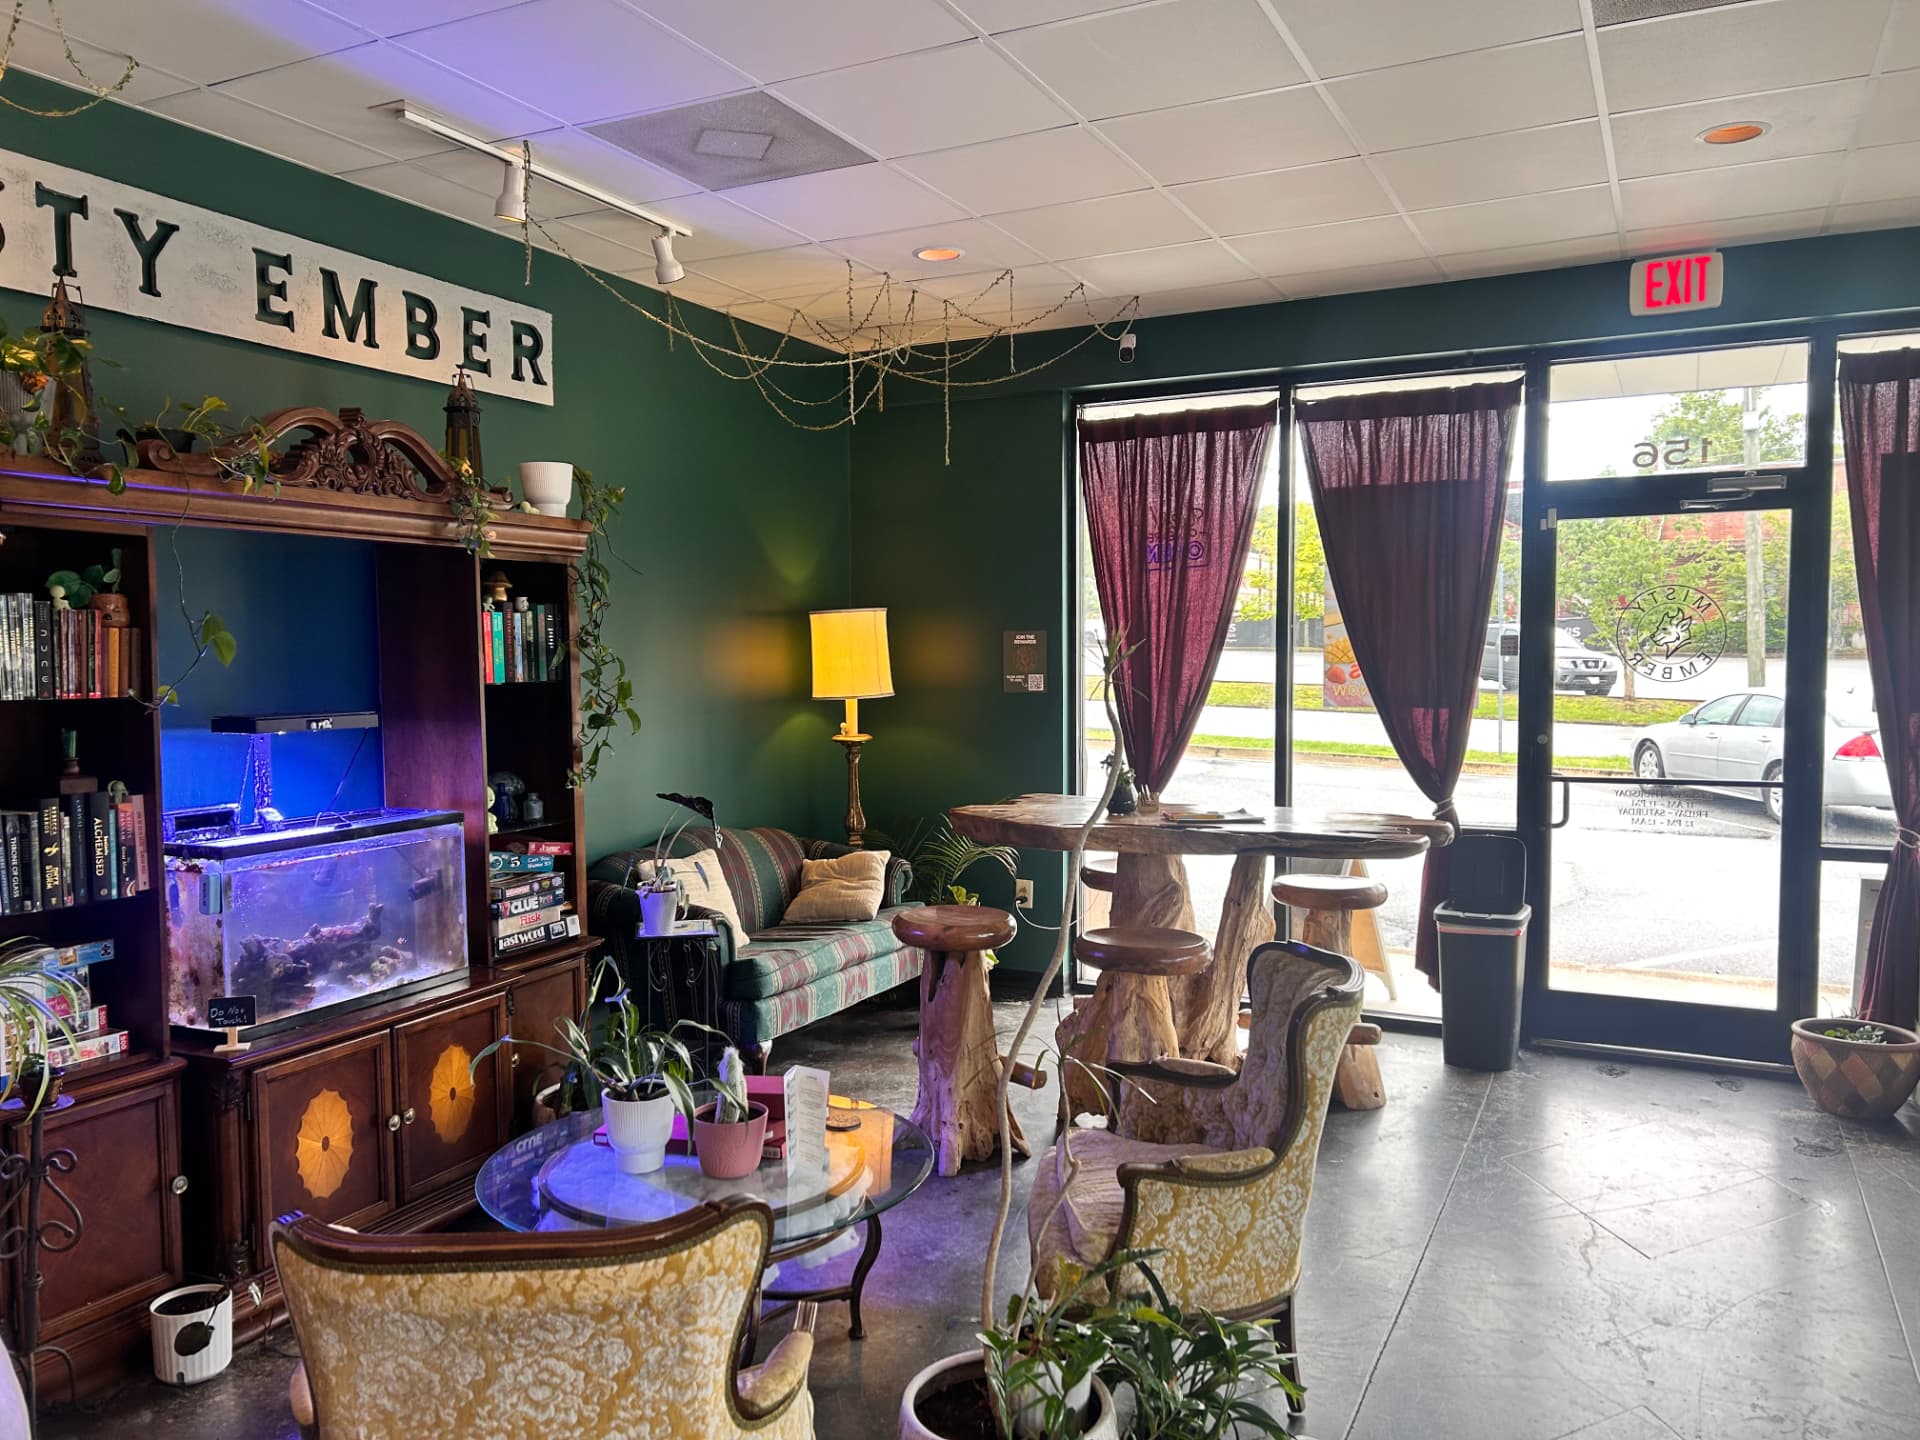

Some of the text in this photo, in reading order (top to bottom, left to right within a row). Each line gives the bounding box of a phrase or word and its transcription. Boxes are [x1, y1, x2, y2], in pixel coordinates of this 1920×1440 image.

[0, 180, 548, 386] TY EMBER
[1645, 255, 1712, 308] EXIT
[10, 836, 18, 865] THRONE
[93, 817, 104, 877] ALCHEMISED
[12, 877, 20, 898] GLASS
[510, 896, 539, 914] CLUE
[520, 913, 542, 926] Risk
[210, 1007, 225, 1018] Do
